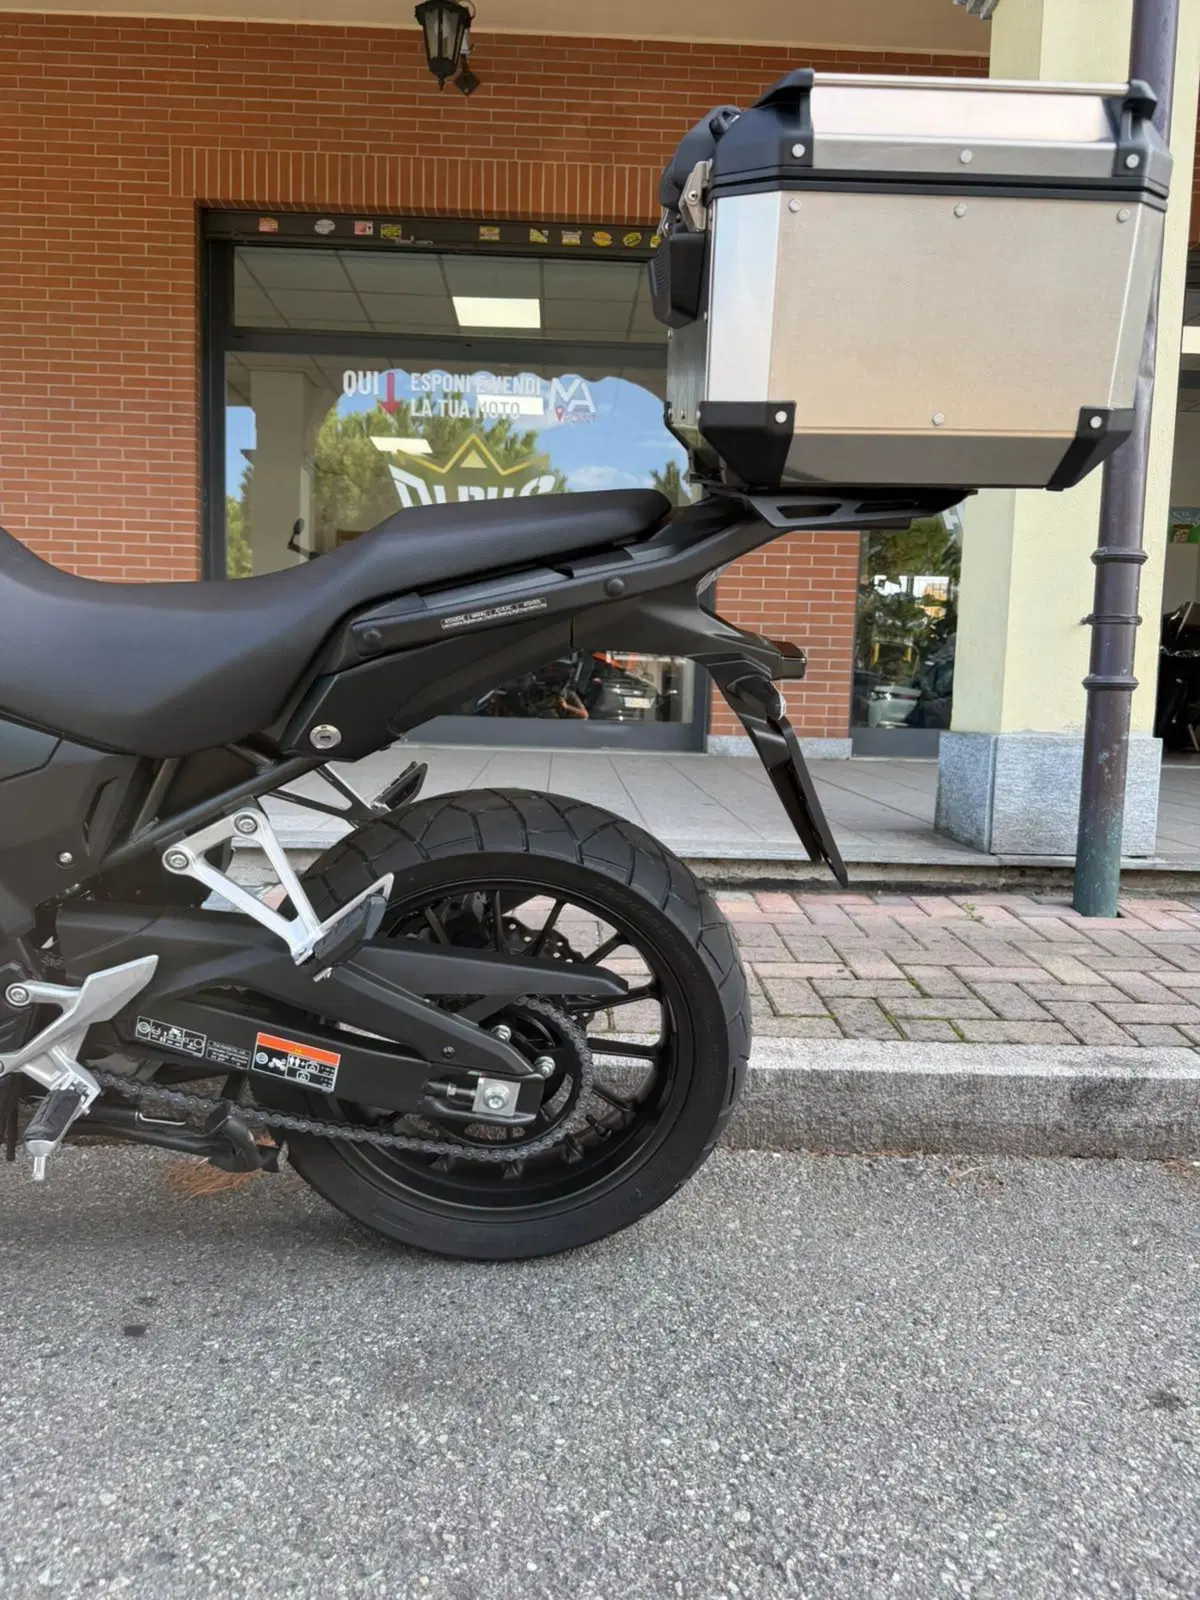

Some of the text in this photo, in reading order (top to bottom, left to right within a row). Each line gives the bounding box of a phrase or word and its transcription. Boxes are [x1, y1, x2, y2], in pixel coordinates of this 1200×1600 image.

[342, 370, 379, 397] QUI
[411, 373, 541, 395] ESPONI E VENDI
[411, 397, 521, 420] LA TUA MOTO
